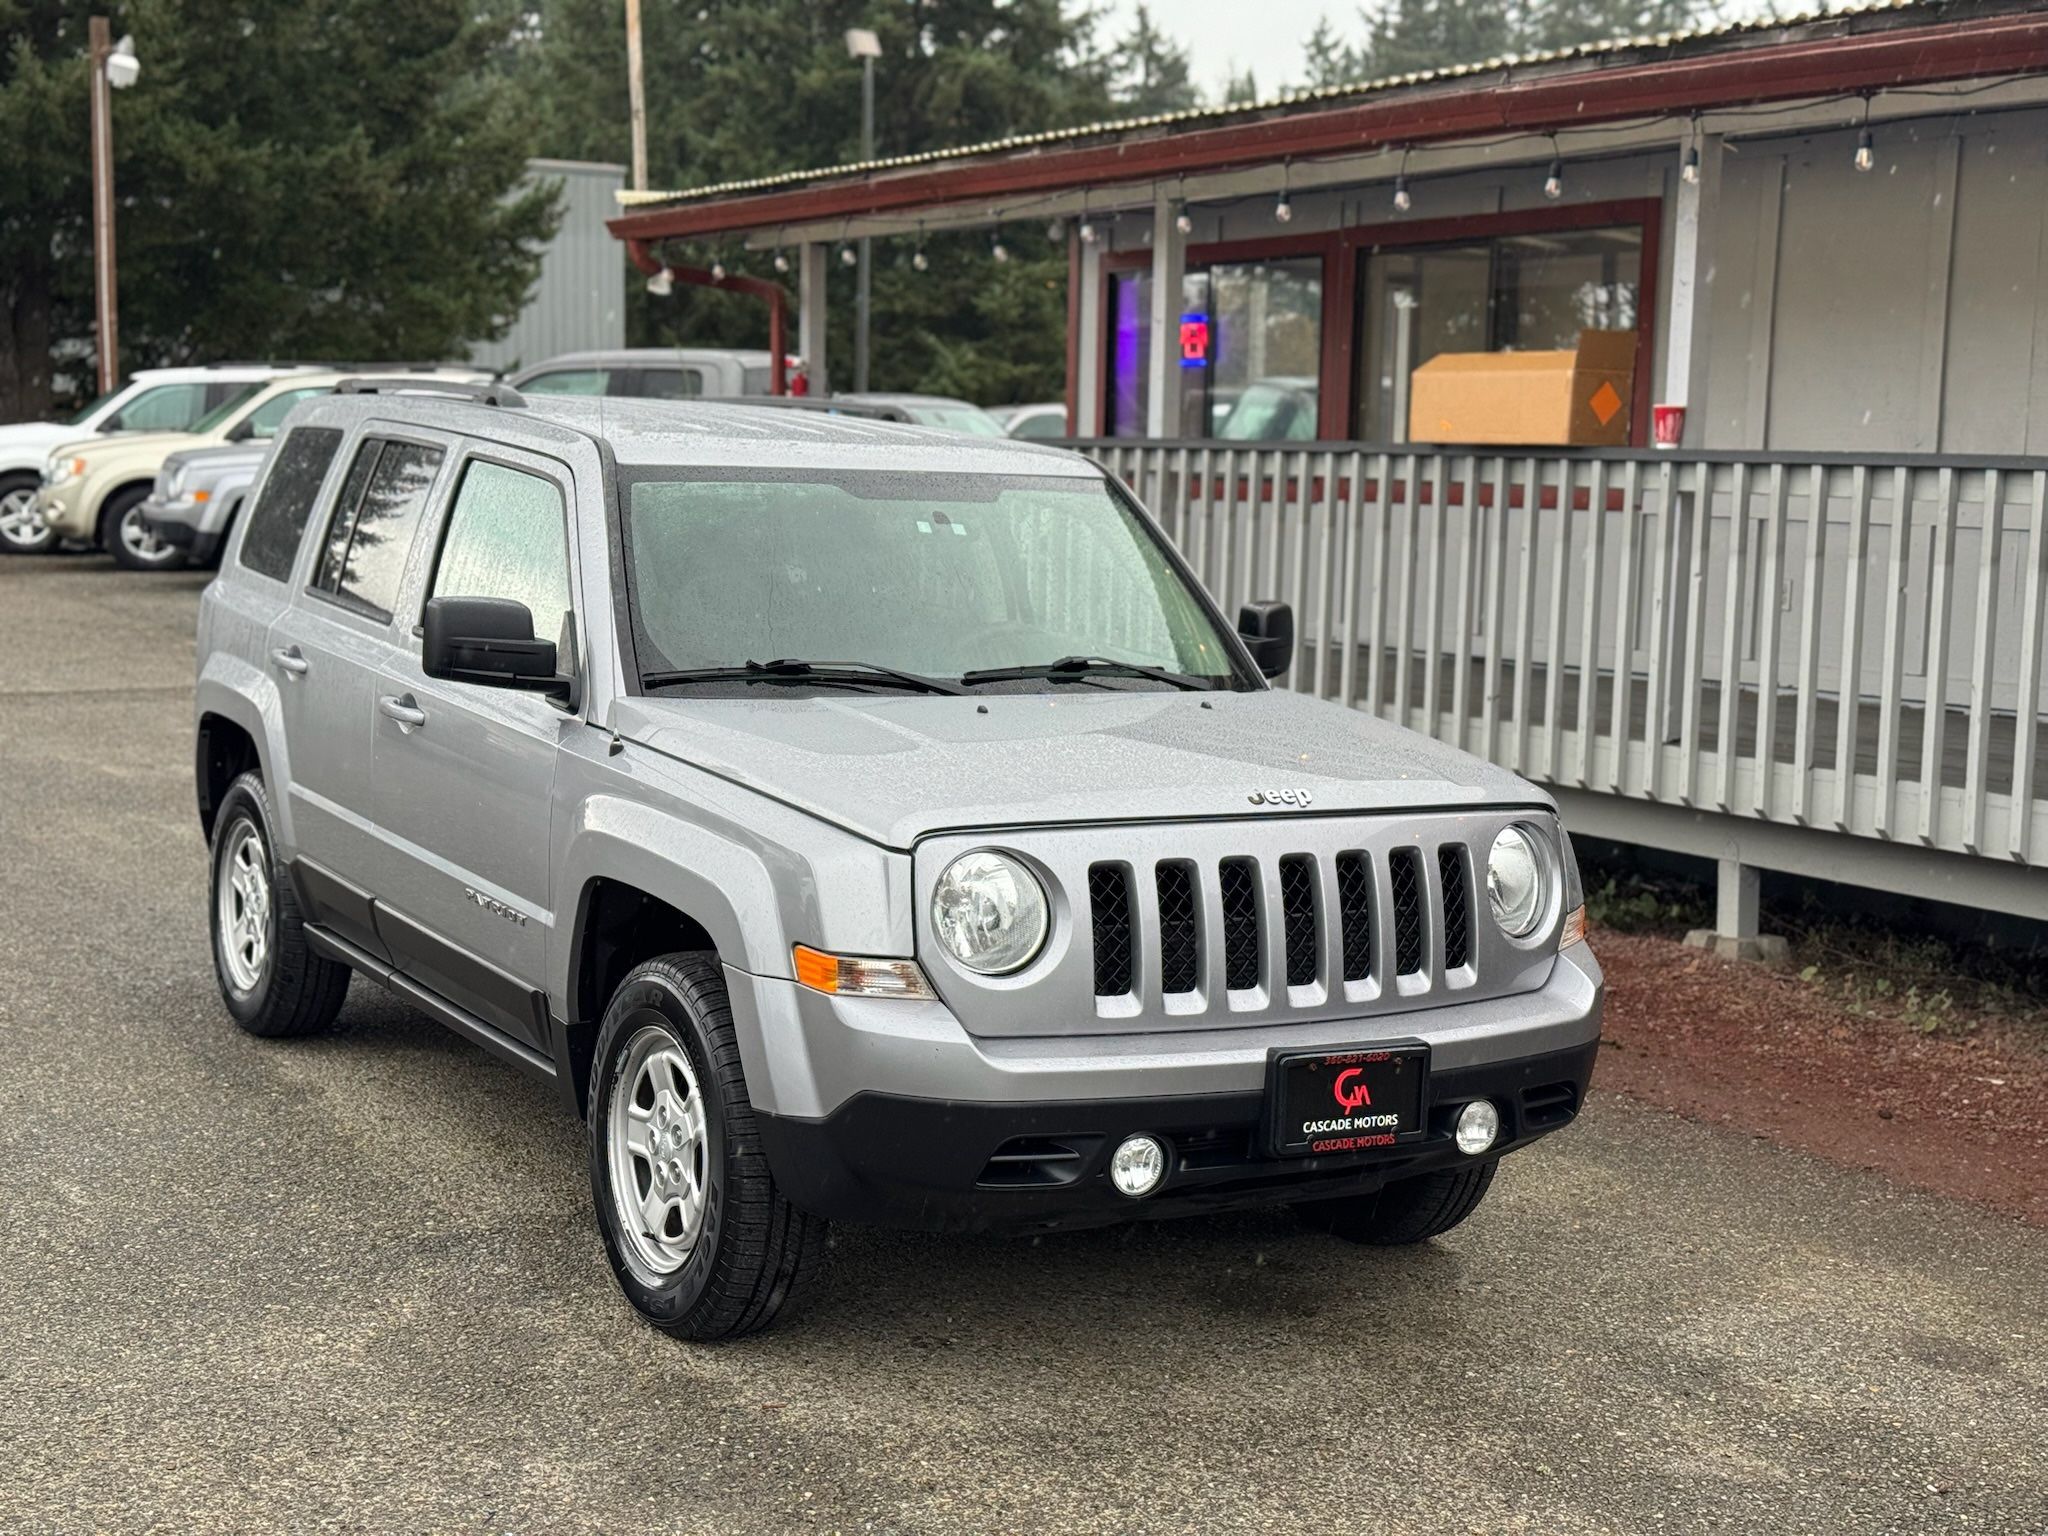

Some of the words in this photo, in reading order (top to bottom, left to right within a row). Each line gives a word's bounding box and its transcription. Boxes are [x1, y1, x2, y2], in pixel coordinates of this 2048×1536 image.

[1247, 788, 1313, 808] Jeep
[1303, 1118, 1352, 1134] CASCADE
[1353, 1113, 1399, 1129] MOTORS
[1312, 1138, 1355, 1152] CASCADE
[1356, 1134, 1395, 1147] MOTORS
